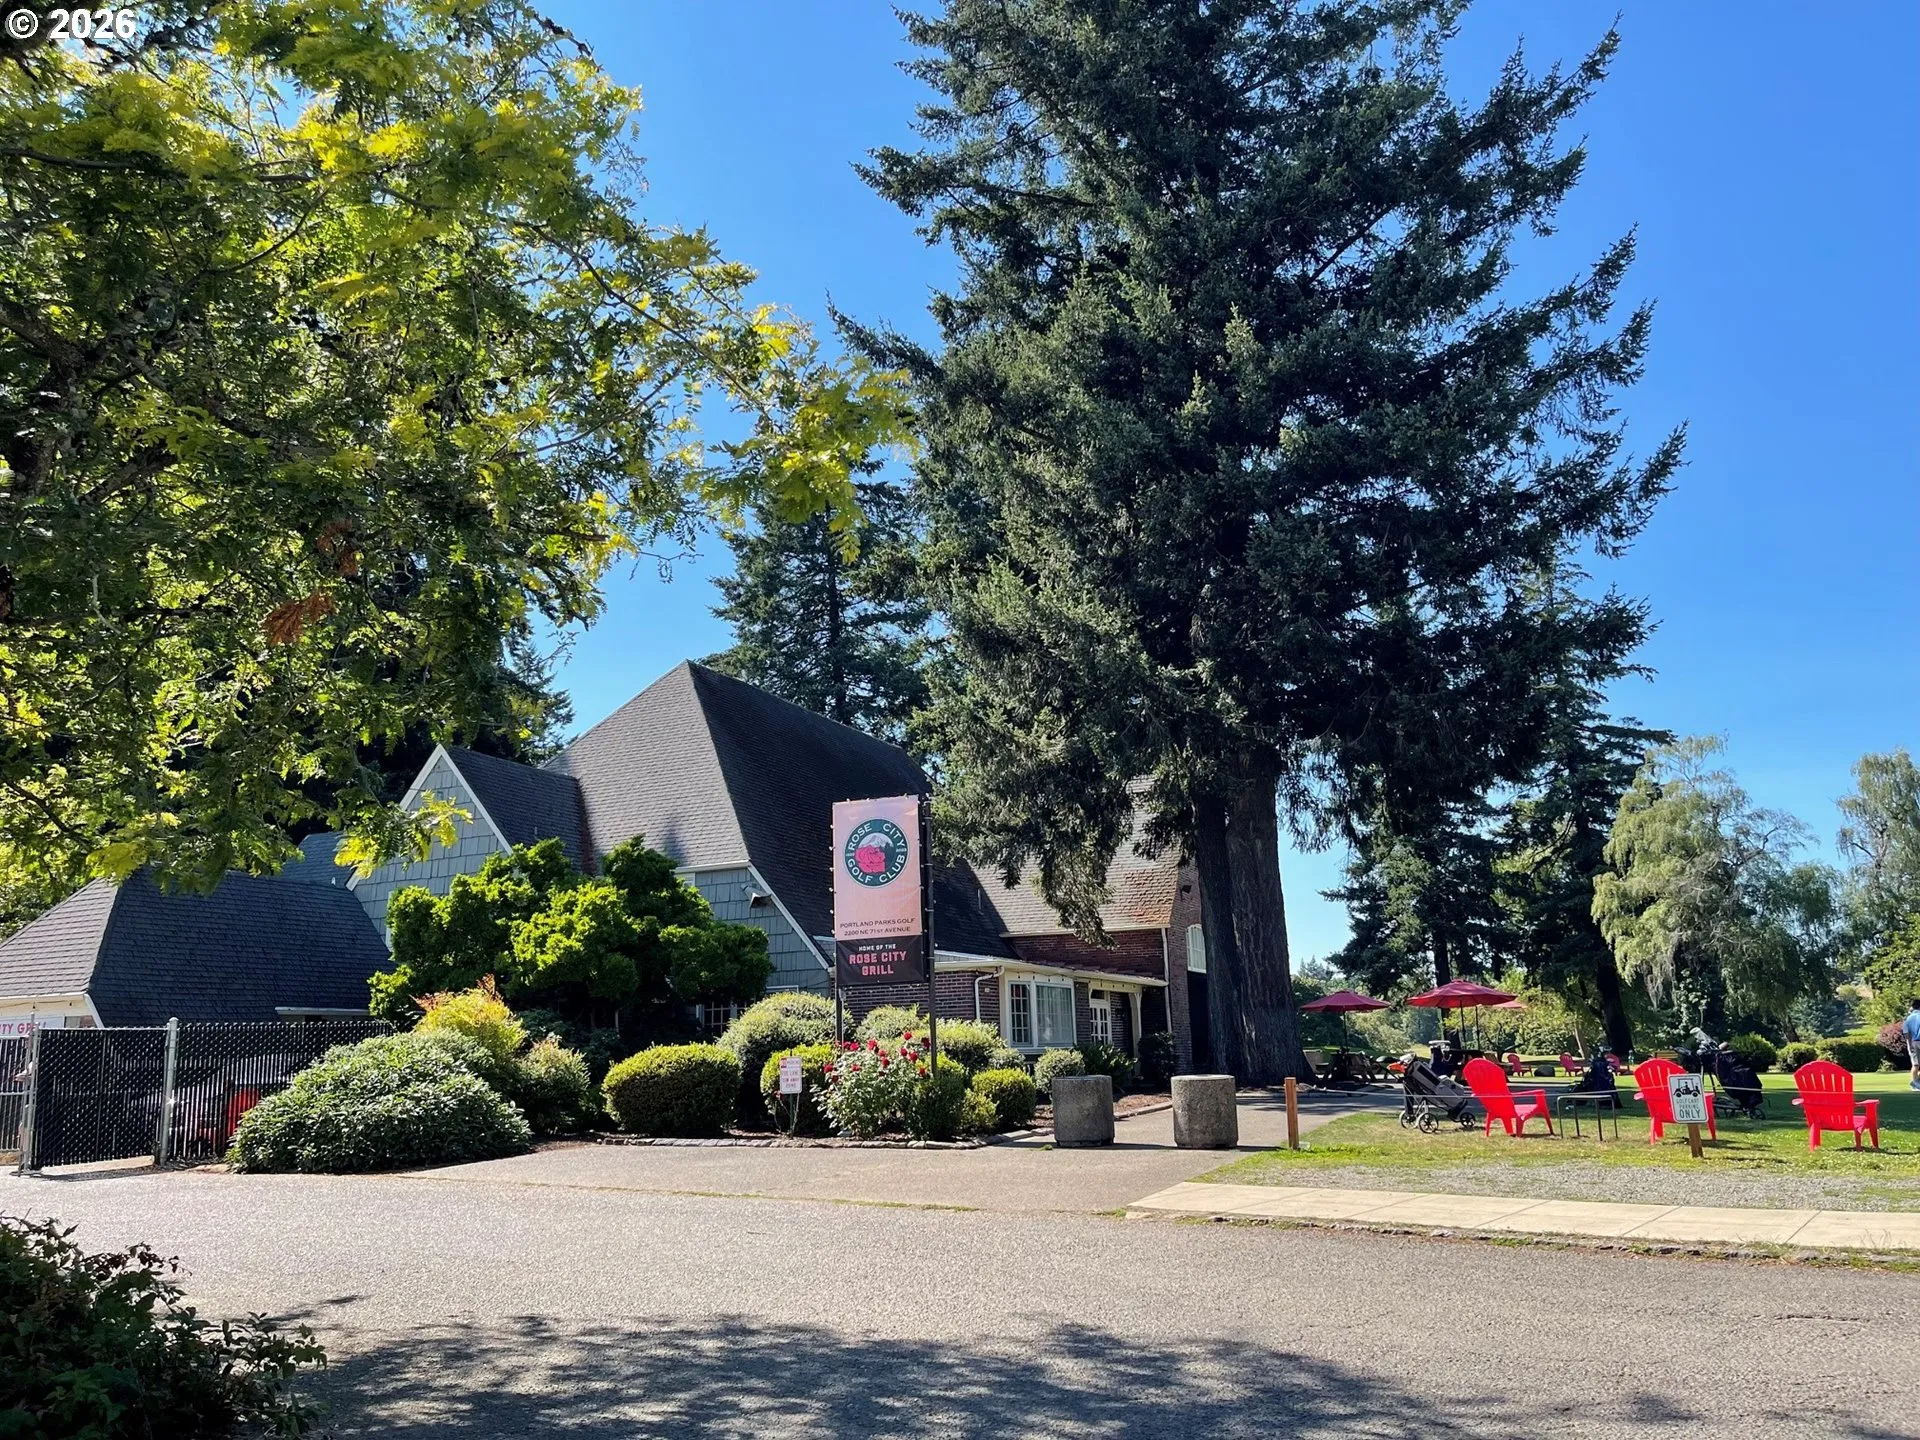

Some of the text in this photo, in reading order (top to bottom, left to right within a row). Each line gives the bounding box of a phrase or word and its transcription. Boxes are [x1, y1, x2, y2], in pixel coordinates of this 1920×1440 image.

[848, 822, 906, 851] ROSE CITY
[847, 854, 906, 884] GOLF CLUB
[840, 920, 874, 929] PORTLAND
[849, 951, 907, 965] ROSE CITY
[861, 964, 894, 976] GRILL
[1679, 1109, 1701, 1119] ONLY
